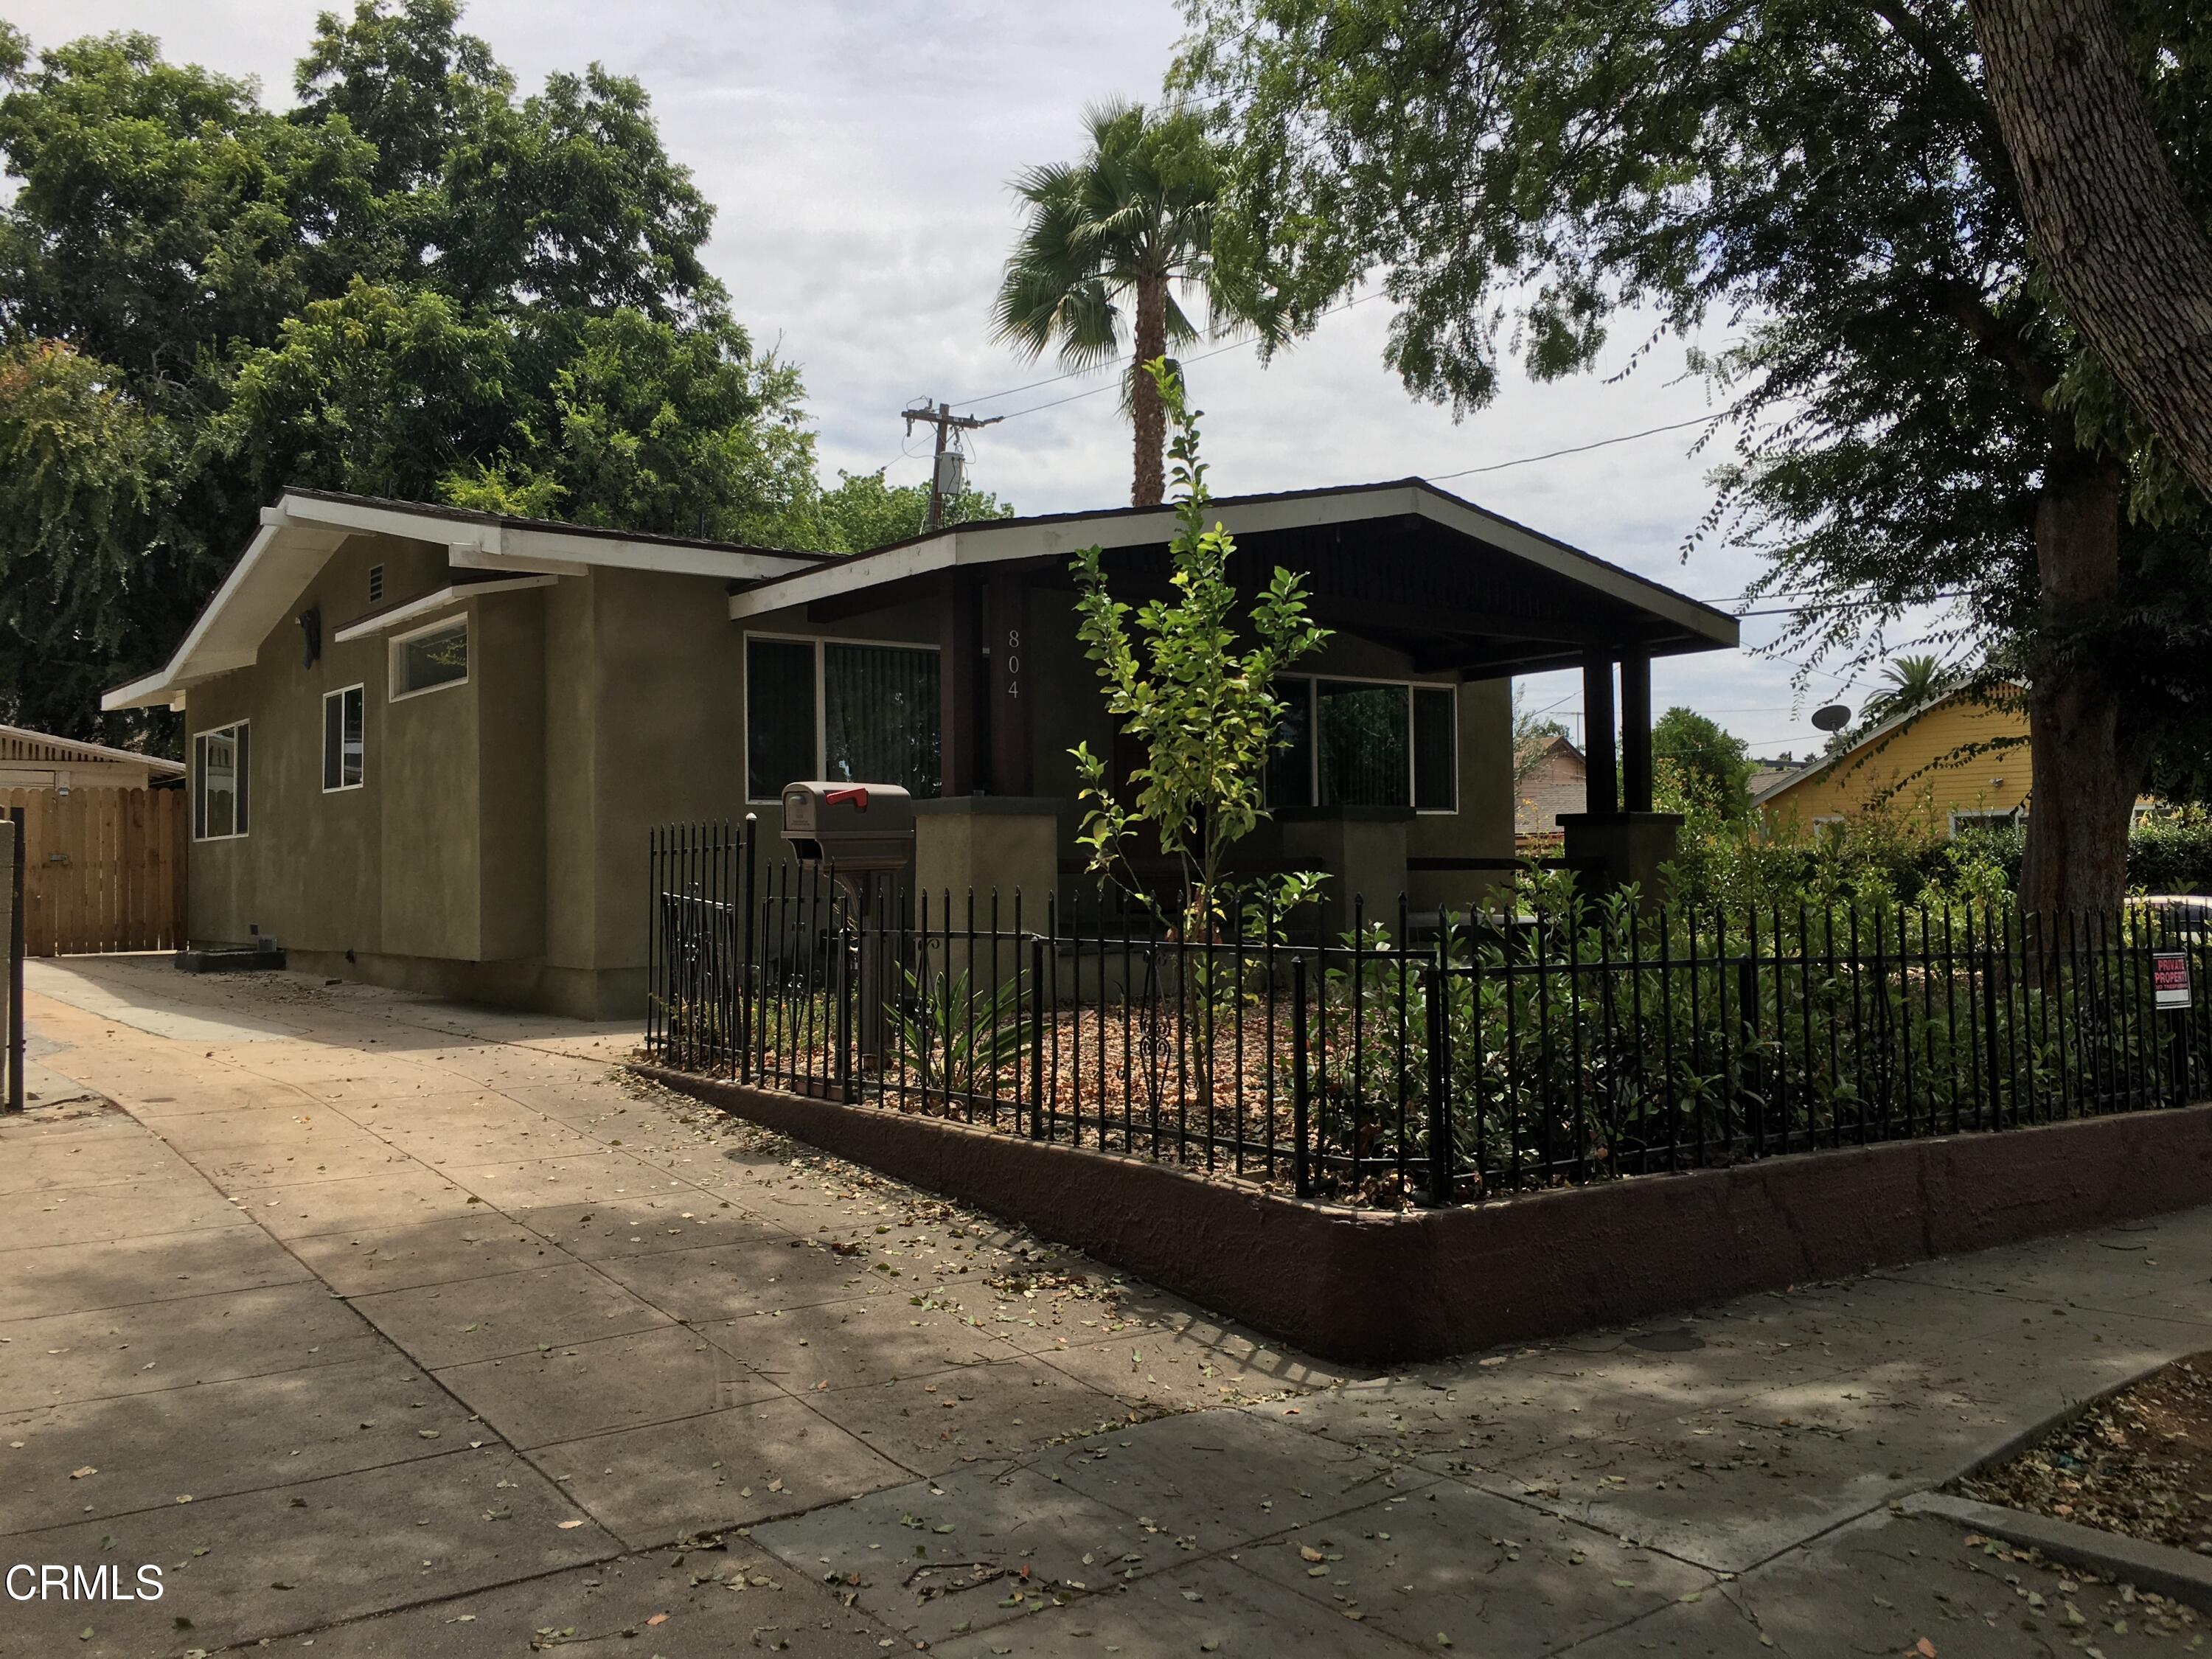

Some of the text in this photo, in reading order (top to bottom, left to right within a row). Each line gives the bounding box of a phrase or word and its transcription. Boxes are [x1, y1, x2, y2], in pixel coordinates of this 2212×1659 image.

[1009, 630, 1019, 699] 804
[2157, 959, 2185, 971] PRIVATE
[2154, 971, 2187, 984] PROPERTY
